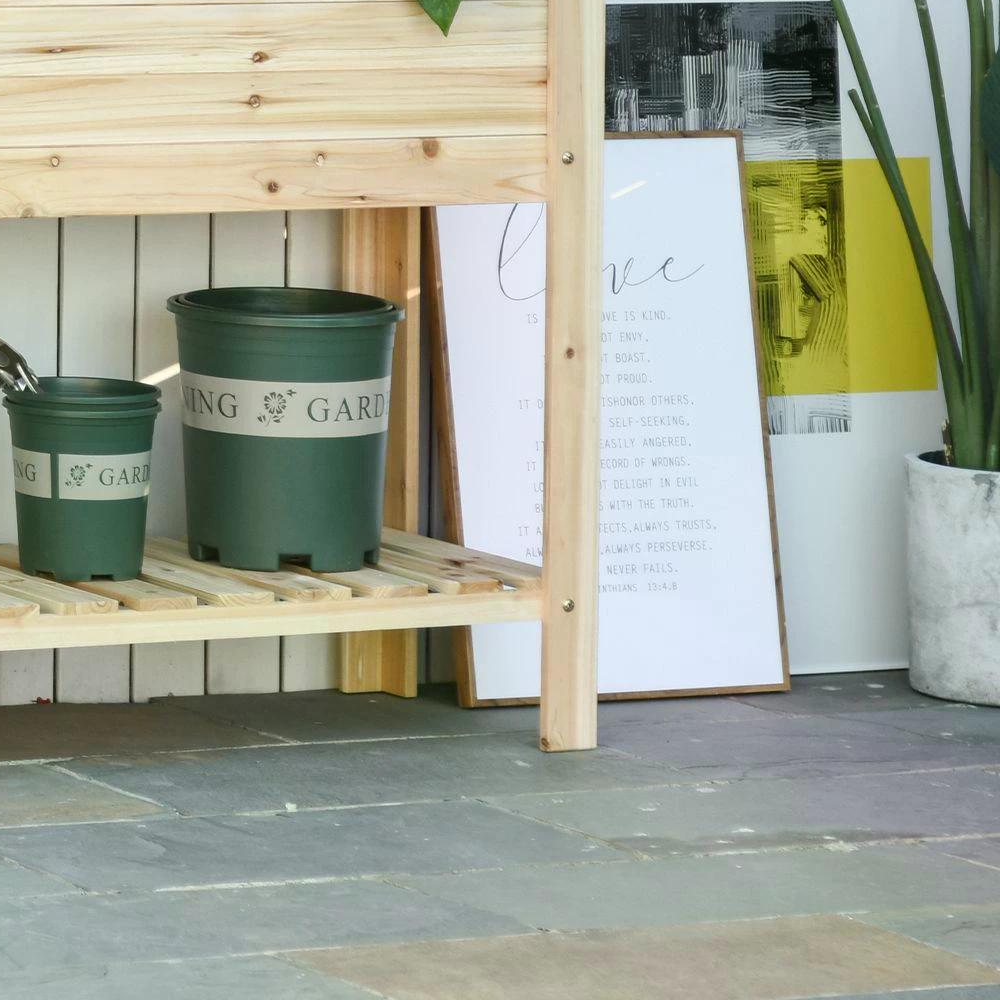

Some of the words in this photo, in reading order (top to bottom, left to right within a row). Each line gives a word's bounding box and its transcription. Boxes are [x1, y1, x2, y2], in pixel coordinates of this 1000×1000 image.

[527, 313, 538, 324] IS
[601, 311, 617, 322] OVE
[624, 310, 636, 321] IS
[642, 310, 671, 320] KIND.
[601, 332, 612, 343] OT
[620, 332, 649, 342] ENVY.
[616, 352, 651, 363] BOAST.
[617, 373, 653, 384] PROUD.
[307, 393, 385, 423] GARD
[518, 399, 529, 410] IT
[601, 396, 646, 407] ISHONOR
[651, 394, 694, 406] OTHERS.
[642, 436, 692, 448] ANGERED.
[526, 461, 536, 472] IT
[600, 458, 629, 469] ECORD
[634, 458, 646, 468] OF
[651, 456, 690, 468] WRONGS.
[99, 464, 151, 486] GARD
[614, 478, 653, 490] DELIGHT
[660, 478, 671, 488] IN
[676, 476, 700, 488] EVIL
[610, 500, 633, 511] WITH
[639, 499, 656, 510] THE
[660, 498, 695, 509] TRUTH.
[606, 564, 638, 575] NEVER
[644, 562, 678, 574] FAILS.
